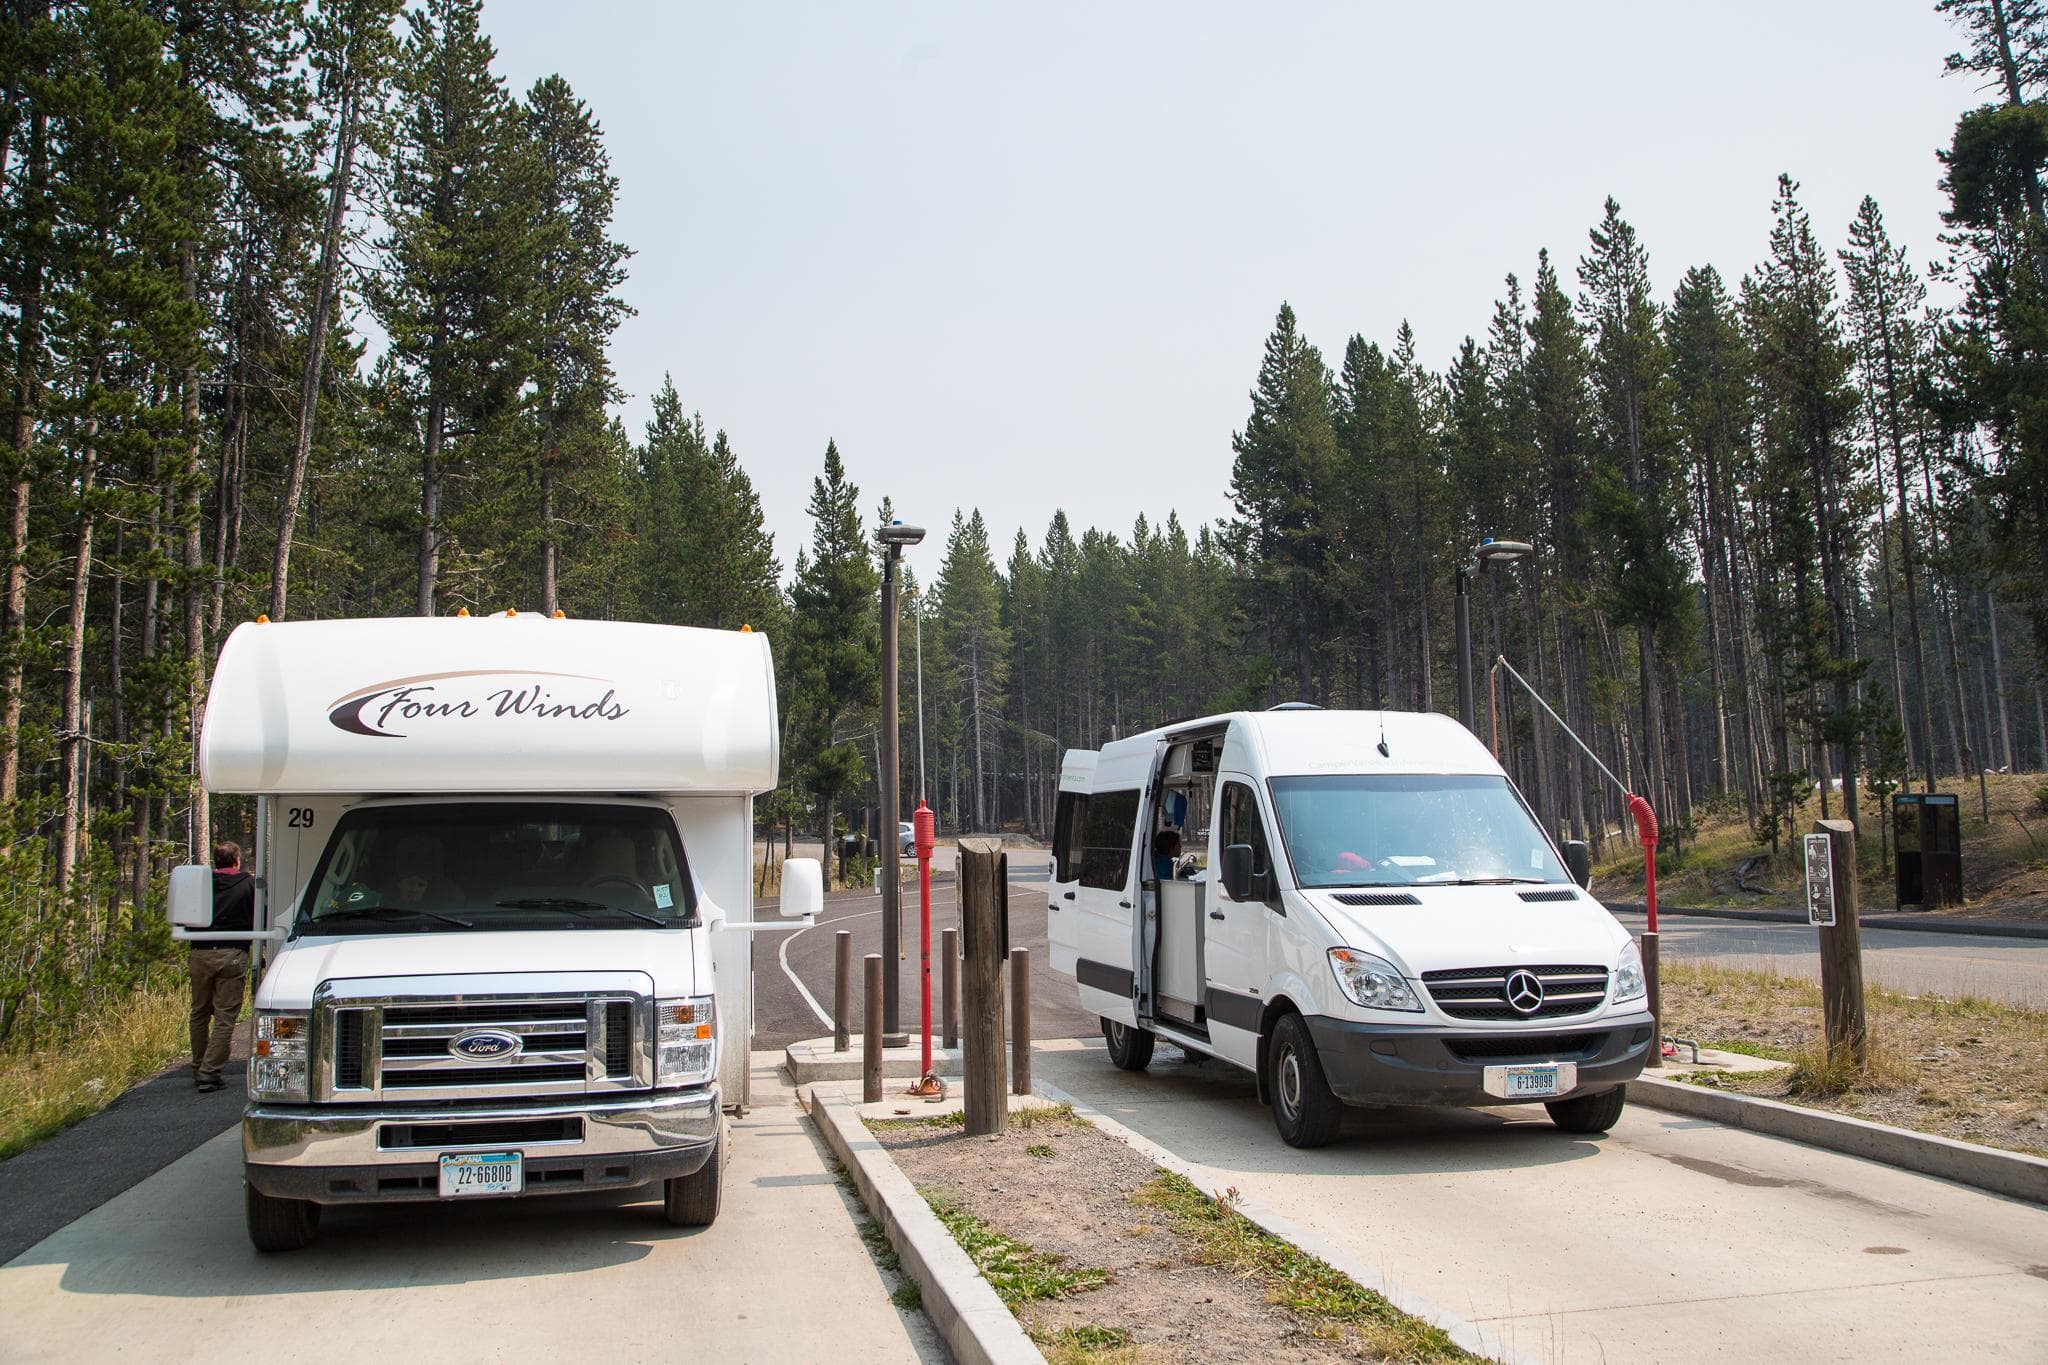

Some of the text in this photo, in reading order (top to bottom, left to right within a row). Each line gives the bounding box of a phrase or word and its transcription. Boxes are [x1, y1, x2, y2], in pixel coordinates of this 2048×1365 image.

[378, 686, 479, 728] Four
[487, 685, 630, 721] Winds
[288, 808, 314, 829] 29
[468, 1038, 500, 1052] Ford
